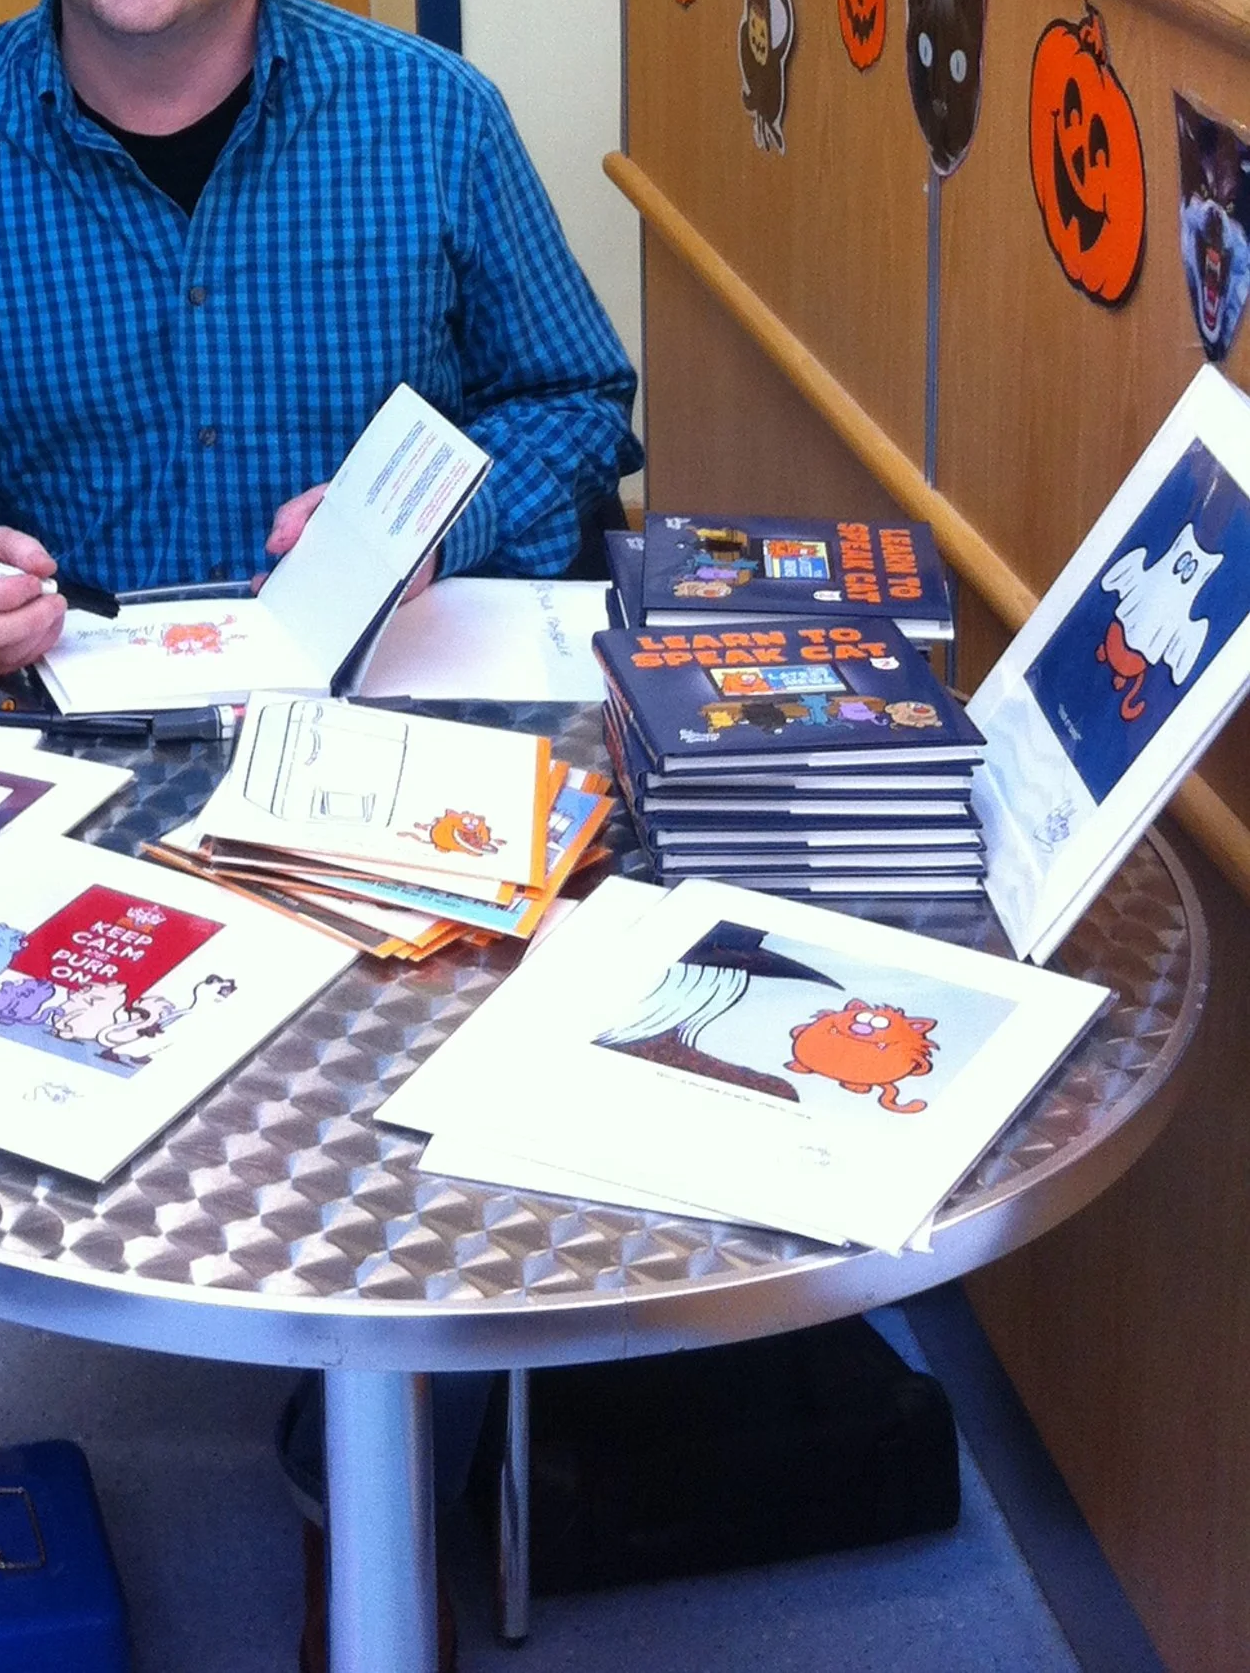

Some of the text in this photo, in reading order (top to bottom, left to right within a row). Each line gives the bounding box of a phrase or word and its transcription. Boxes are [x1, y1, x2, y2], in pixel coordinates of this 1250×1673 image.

[836, 522, 882, 604] SPEAK CAT
[878, 529, 923, 600] LEARN TO
[636, 627, 862, 651] LEARN TO
[630, 642, 888, 668] SPEAK CAT
[71, 931, 145, 962] CALM
[91, 921, 154, 946] KEEP
[50, 966, 92, 984] ON
[51, 948, 119, 978] PURR
